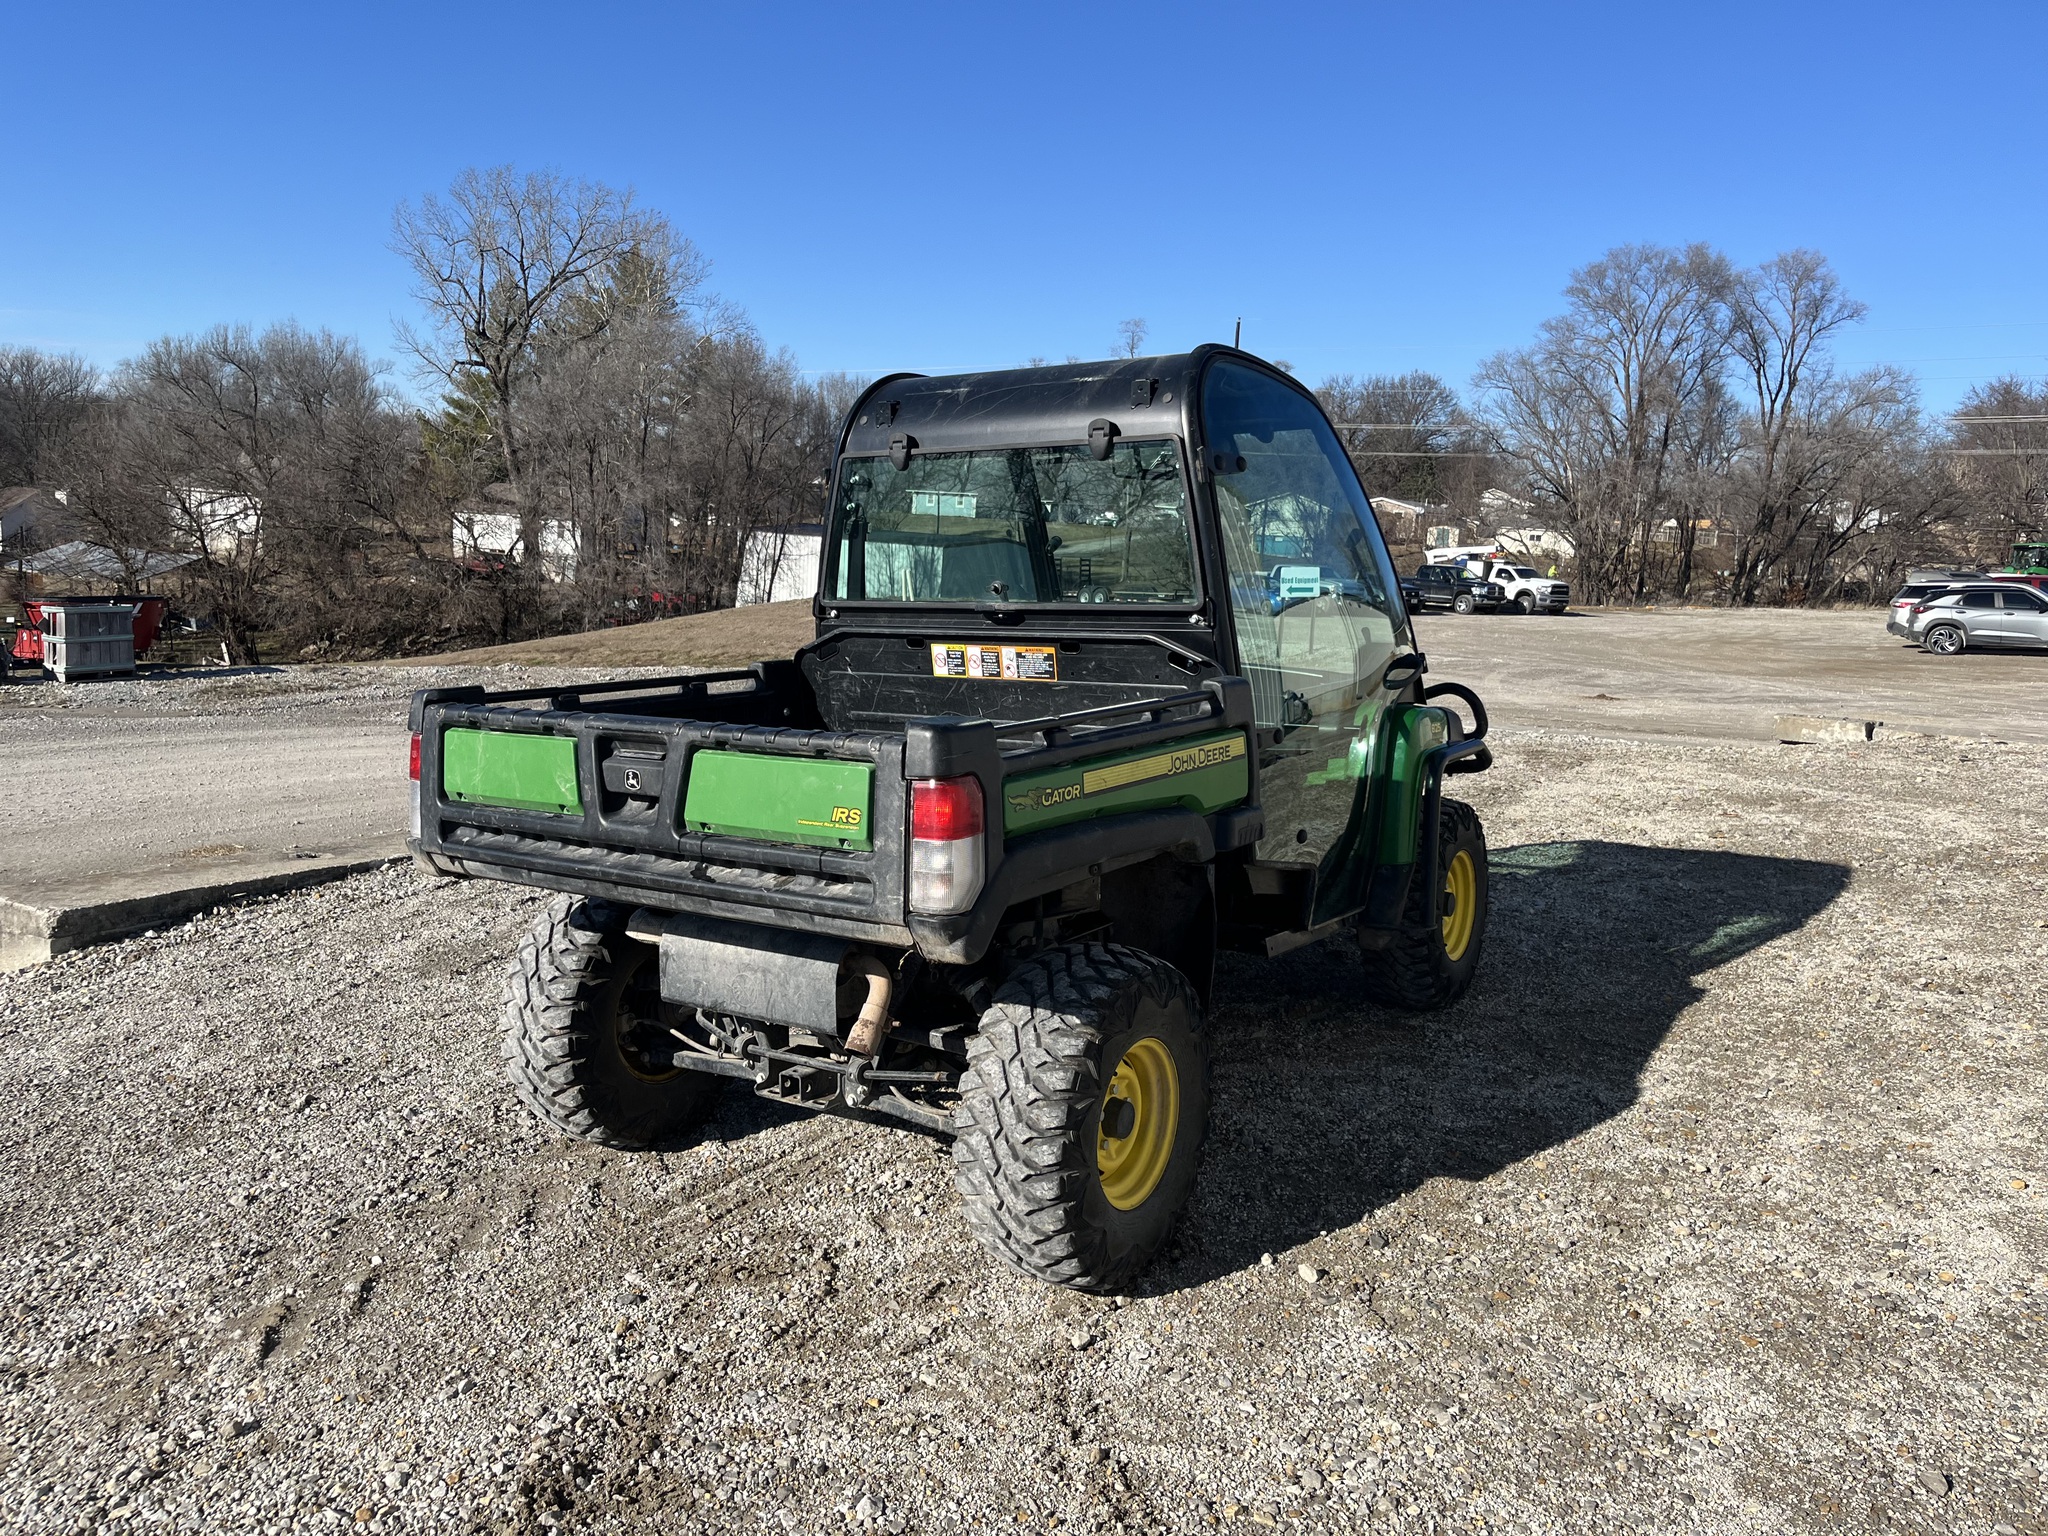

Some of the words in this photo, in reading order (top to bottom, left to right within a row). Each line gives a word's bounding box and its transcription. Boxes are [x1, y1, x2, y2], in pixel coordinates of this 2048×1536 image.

[1168, 752, 1197, 775] JOHN
[1198, 744, 1232, 767] DEERE
[1041, 784, 1081, 807] GATOR
[831, 806, 862, 824] IRS
